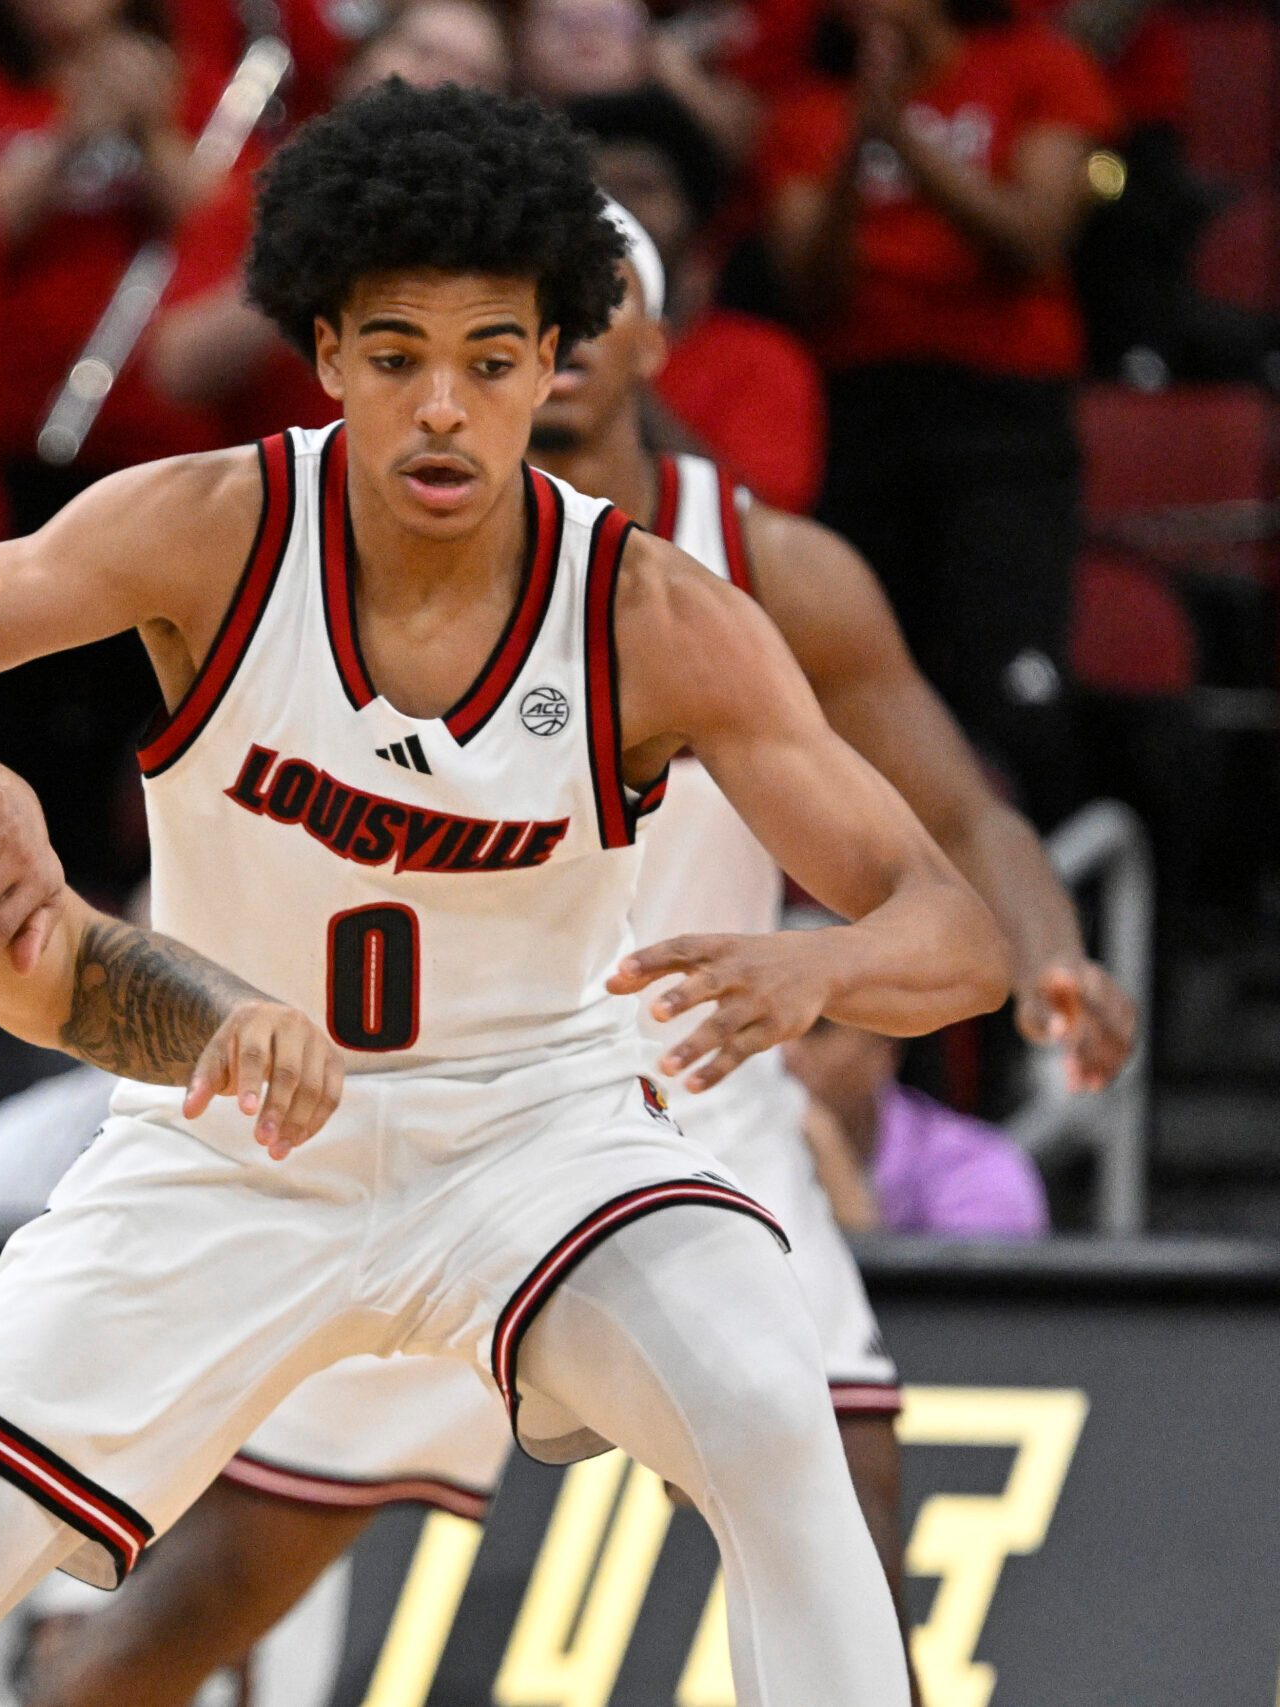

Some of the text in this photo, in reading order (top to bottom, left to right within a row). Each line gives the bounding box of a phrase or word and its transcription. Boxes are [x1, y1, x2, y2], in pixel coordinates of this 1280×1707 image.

[526, 703, 567, 714] ACC
[223, 742, 571, 875] LOUISVILLE
[326, 901, 420, 1053] 0
